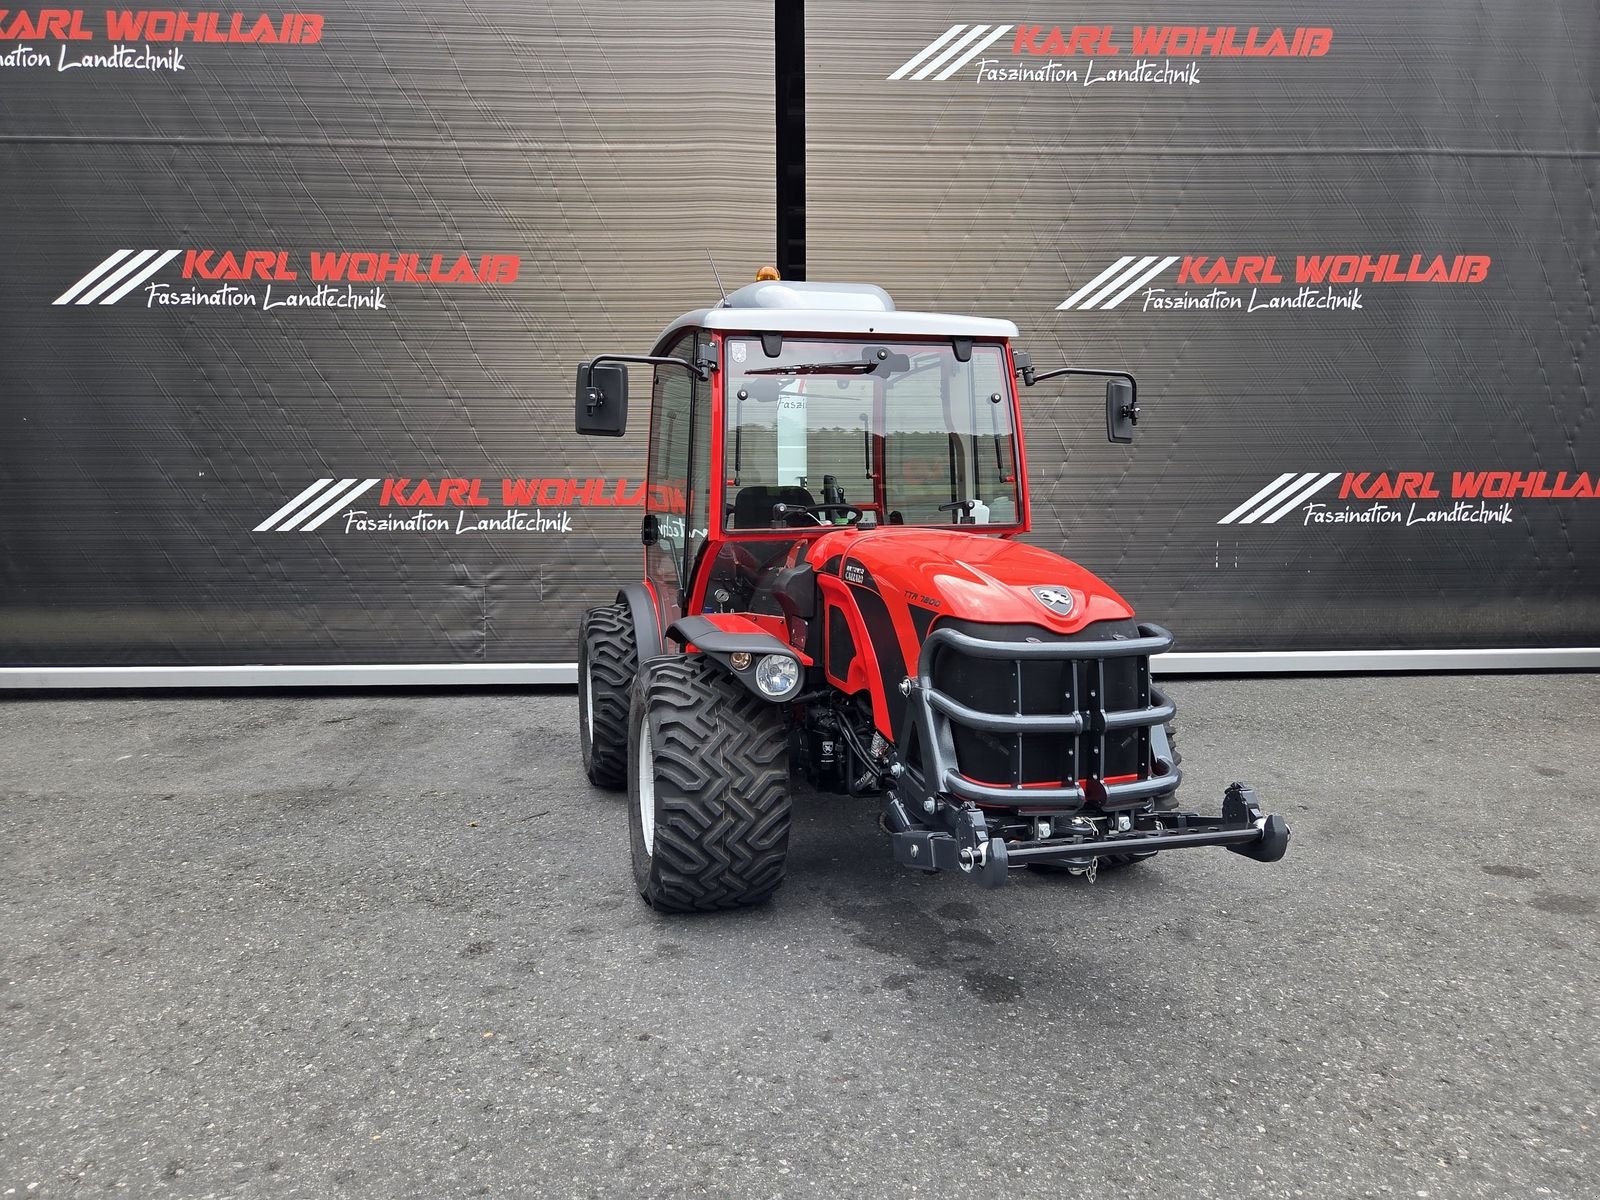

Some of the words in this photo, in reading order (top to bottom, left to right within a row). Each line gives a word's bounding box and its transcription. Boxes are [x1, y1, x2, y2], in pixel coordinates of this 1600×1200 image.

[106, 10, 324, 43] WOHLLAIB
[1011, 26, 1118, 55] KARL
[1132, 26, 1333, 57] WOHLLAIB
[58, 44, 185, 72] Landtechnik
[975, 58, 1077, 84] Faszination
[1083, 59, 1200, 87] Landtechnik
[182, 249, 298, 281] KARL
[310, 252, 521, 284] WOHLLAIB
[1177, 255, 1282, 284] KARL
[1296, 254, 1491, 284] WOHLLAIB
[145, 282, 257, 309] Faszination
[263, 283, 387, 311] Landtechnik
[1141, 286, 1242, 312] Faszination
[1247, 286, 1363, 313] Landtechnik
[379, 479, 490, 507] KARL
[1338, 472, 1440, 499] KARL
[342, 509, 449, 535] Faszination
[455, 508, 573, 535] Landtechnik
[1302, 501, 1401, 526] Faszination
[1406, 501, 1513, 526] Landtechnik
